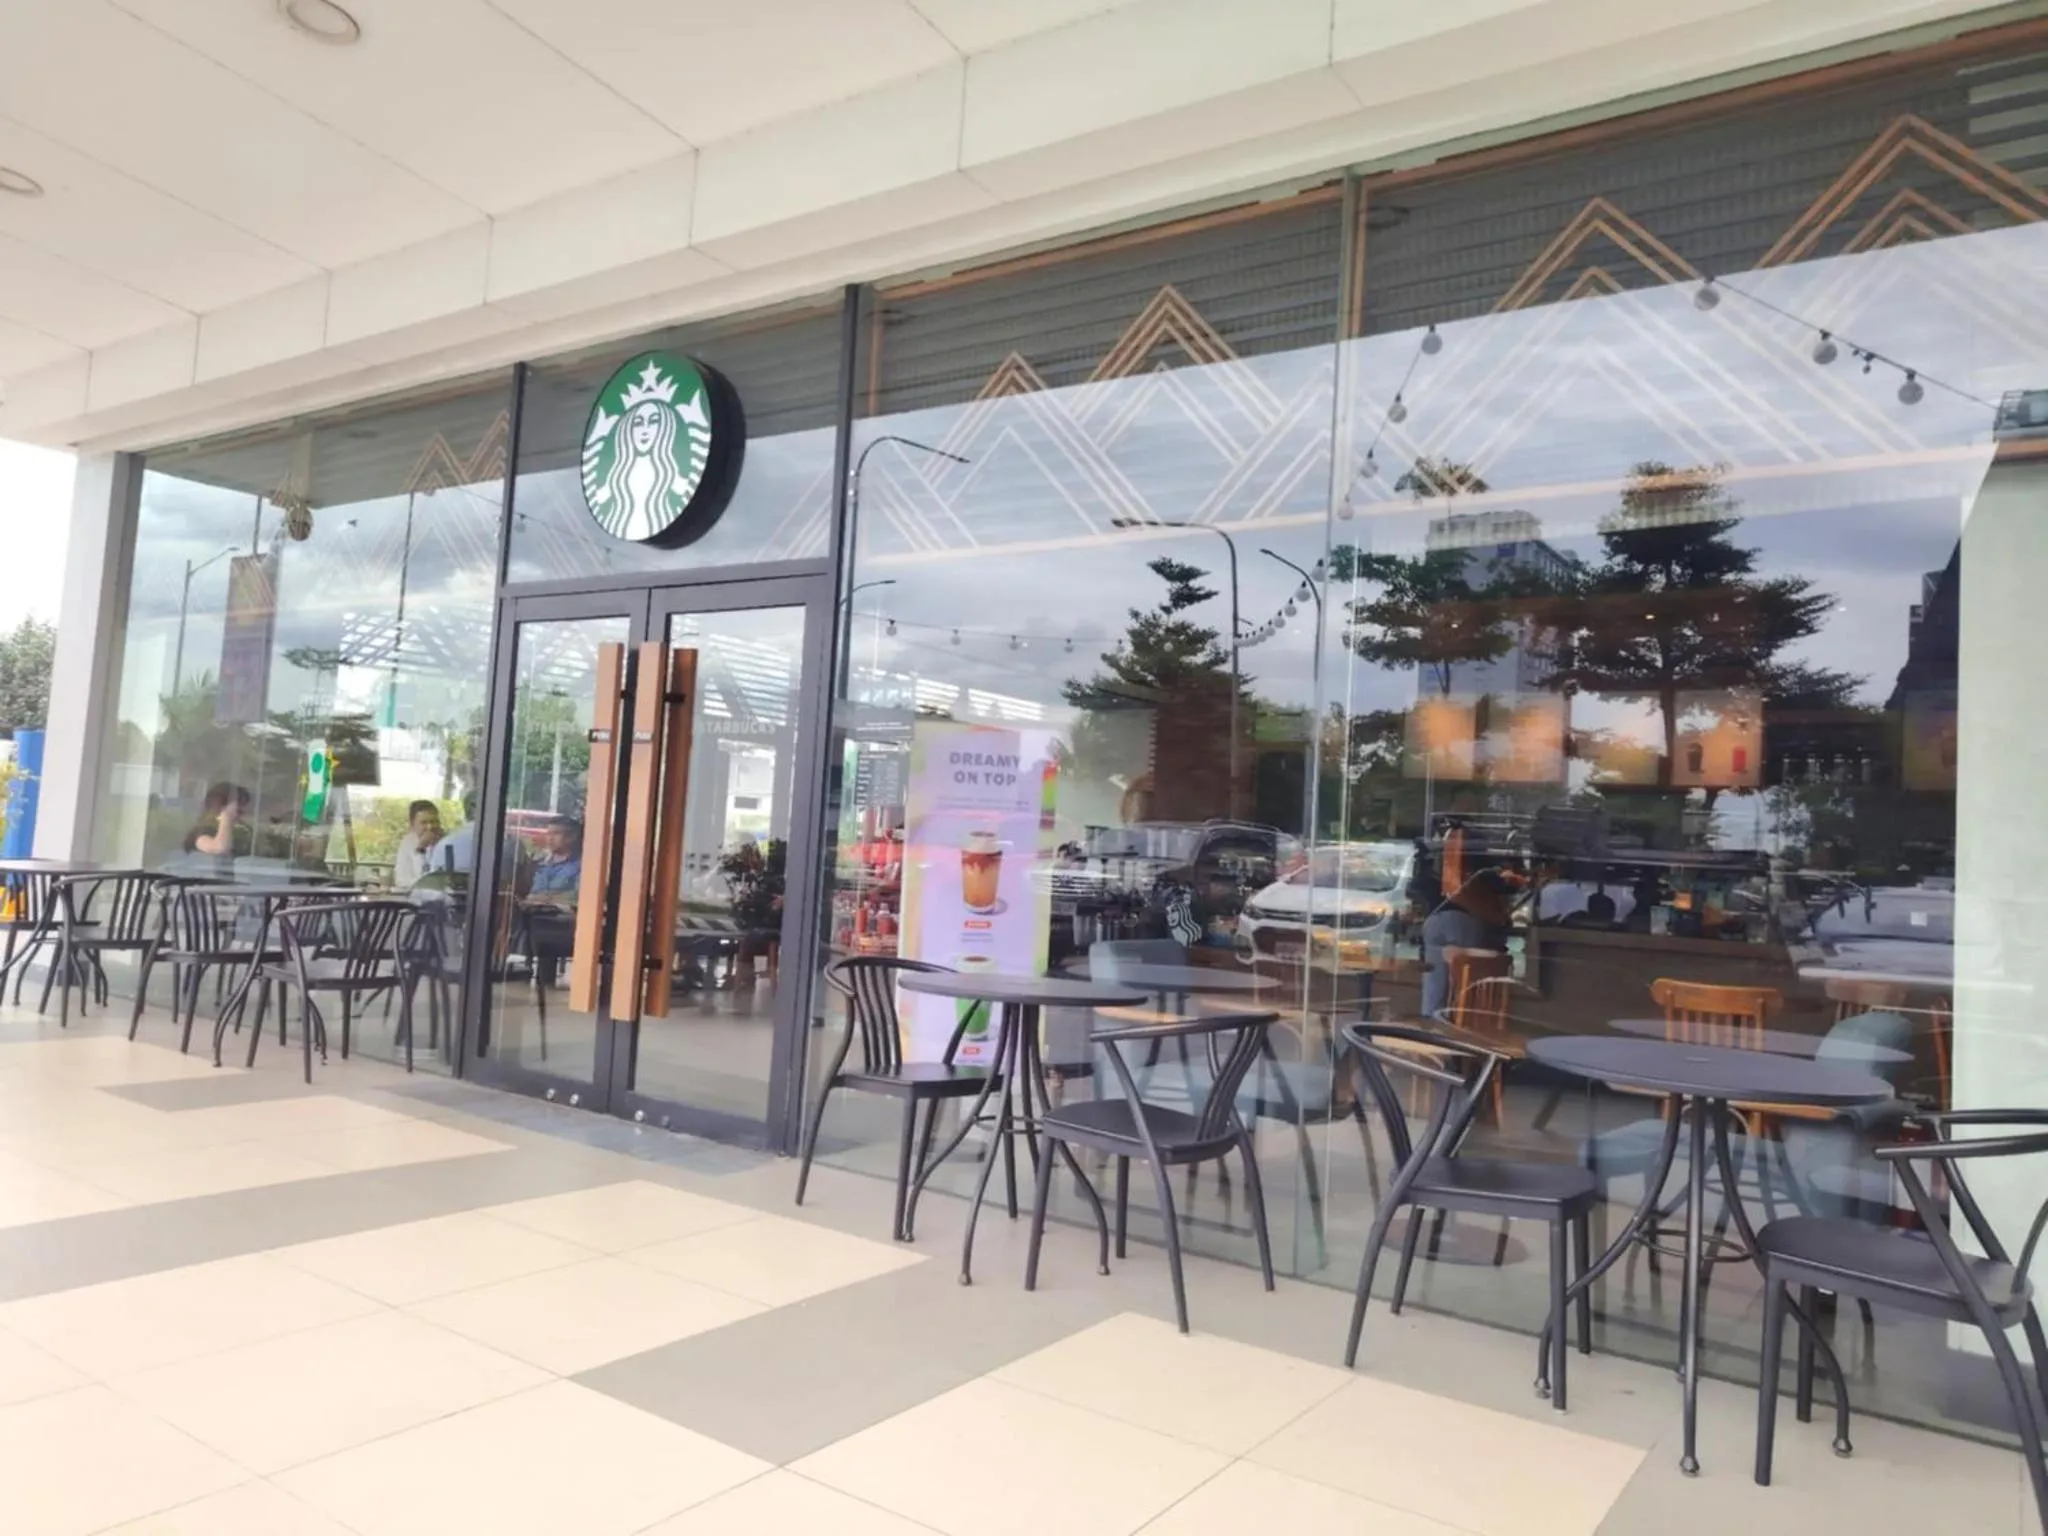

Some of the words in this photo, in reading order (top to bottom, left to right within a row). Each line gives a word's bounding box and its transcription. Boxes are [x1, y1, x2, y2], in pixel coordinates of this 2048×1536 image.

[949, 752, 1021, 769] DREAMY
[953, 770, 978, 785] ON
[983, 772, 1017, 787] TOP
